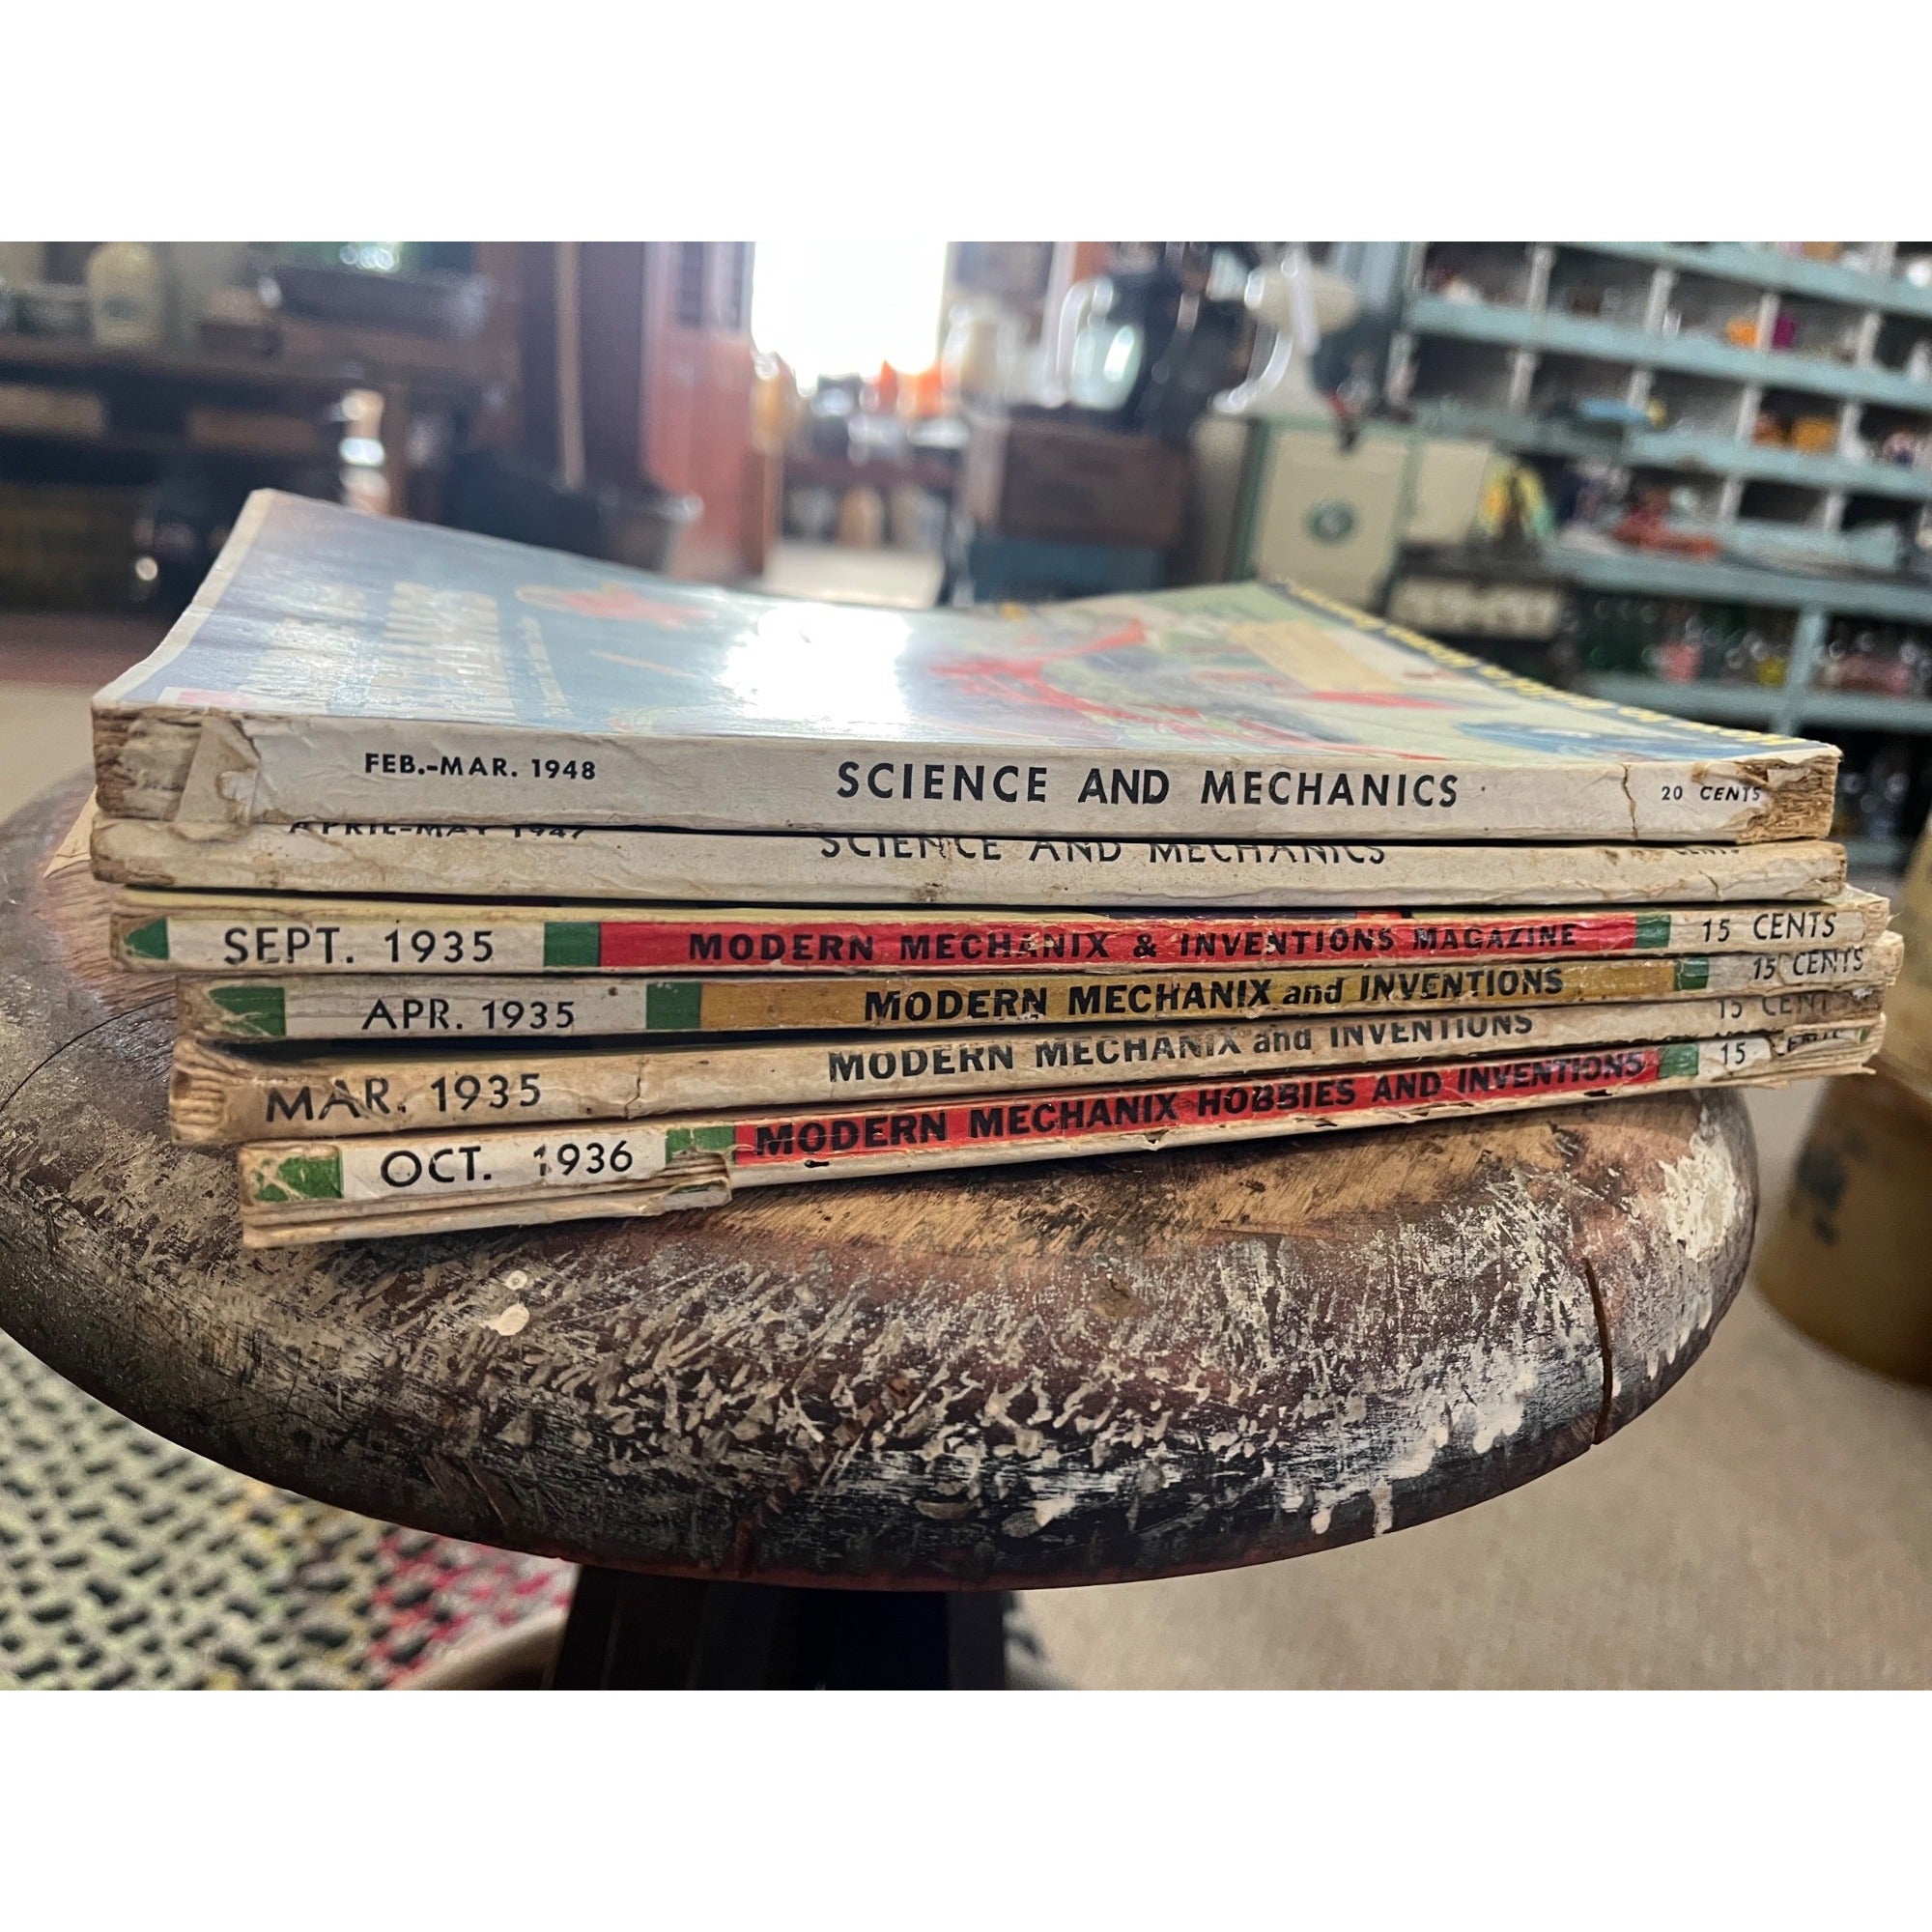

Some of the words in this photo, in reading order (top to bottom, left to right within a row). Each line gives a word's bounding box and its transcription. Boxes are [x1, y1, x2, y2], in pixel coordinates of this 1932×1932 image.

[364, 753, 518, 778] FEB.-MAR.
[530, 758, 596, 780] 1948
[837, 760, 1047, 803] SCIENCE
[1077, 767, 1170, 805] AND
[1200, 769, 1459, 809] MECHANICS
[1662, 785, 1683, 801] 20
[1700, 785, 1761, 802] CENTS
[821, 837, 1002, 860] SCIENCE
[1029, 841, 1122, 863] AND
[1150, 843, 1385, 865] MECHANICS
[689, 932, 873, 961] MODERN
[900, 931, 1110, 960] MECHANIX
[1133, 933, 1157, 957] &
[1180, 927, 1394, 956] INVENTIONS
[1412, 923, 1577, 952] MAGAZINE
[1702, 919, 1730, 943] 15
[1753, 911, 1837, 941] CENTS
[224, 926, 354, 965] SEPT.
[384, 929, 495, 963] 1935
[1752, 957, 1776, 980] 15
[1793, 948, 1864, 976] CENTS
[865, 986, 1047, 1021] MODERN
[1068, 979, 1272, 1015] MECHANIX
[1282, 976, 1345, 1006] and
[1360, 967, 1564, 1002] INVENTIONS
[1717, 998, 1744, 1019] 15
[361, 998, 463, 1031] APR.
[482, 1000, 575, 1031] 1935
[828, 1045, 1013, 1083] MODERN
[1036, 1027, 1242, 1067] MECHANIX
[1253, 1028, 1312, 1054] and
[1330, 1014, 1534, 1048] INVENTIONS
[1720, 1042, 1747, 1065] 15
[266, 1078, 408, 1122] MAR.
[430, 1073, 542, 1114] 1935
[756, 1113, 949, 1156] MODERN
[969, 1093, 1178, 1139] MECHANIX
[1196, 1079, 1357, 1118] HOBBIES
[1371, 1071, 1444, 1102] AND
[1457, 1052, 1646, 1095] INVENTIONS
[381, 1146, 493, 1188] OCT.
[532, 1140, 635, 1178] 1936
